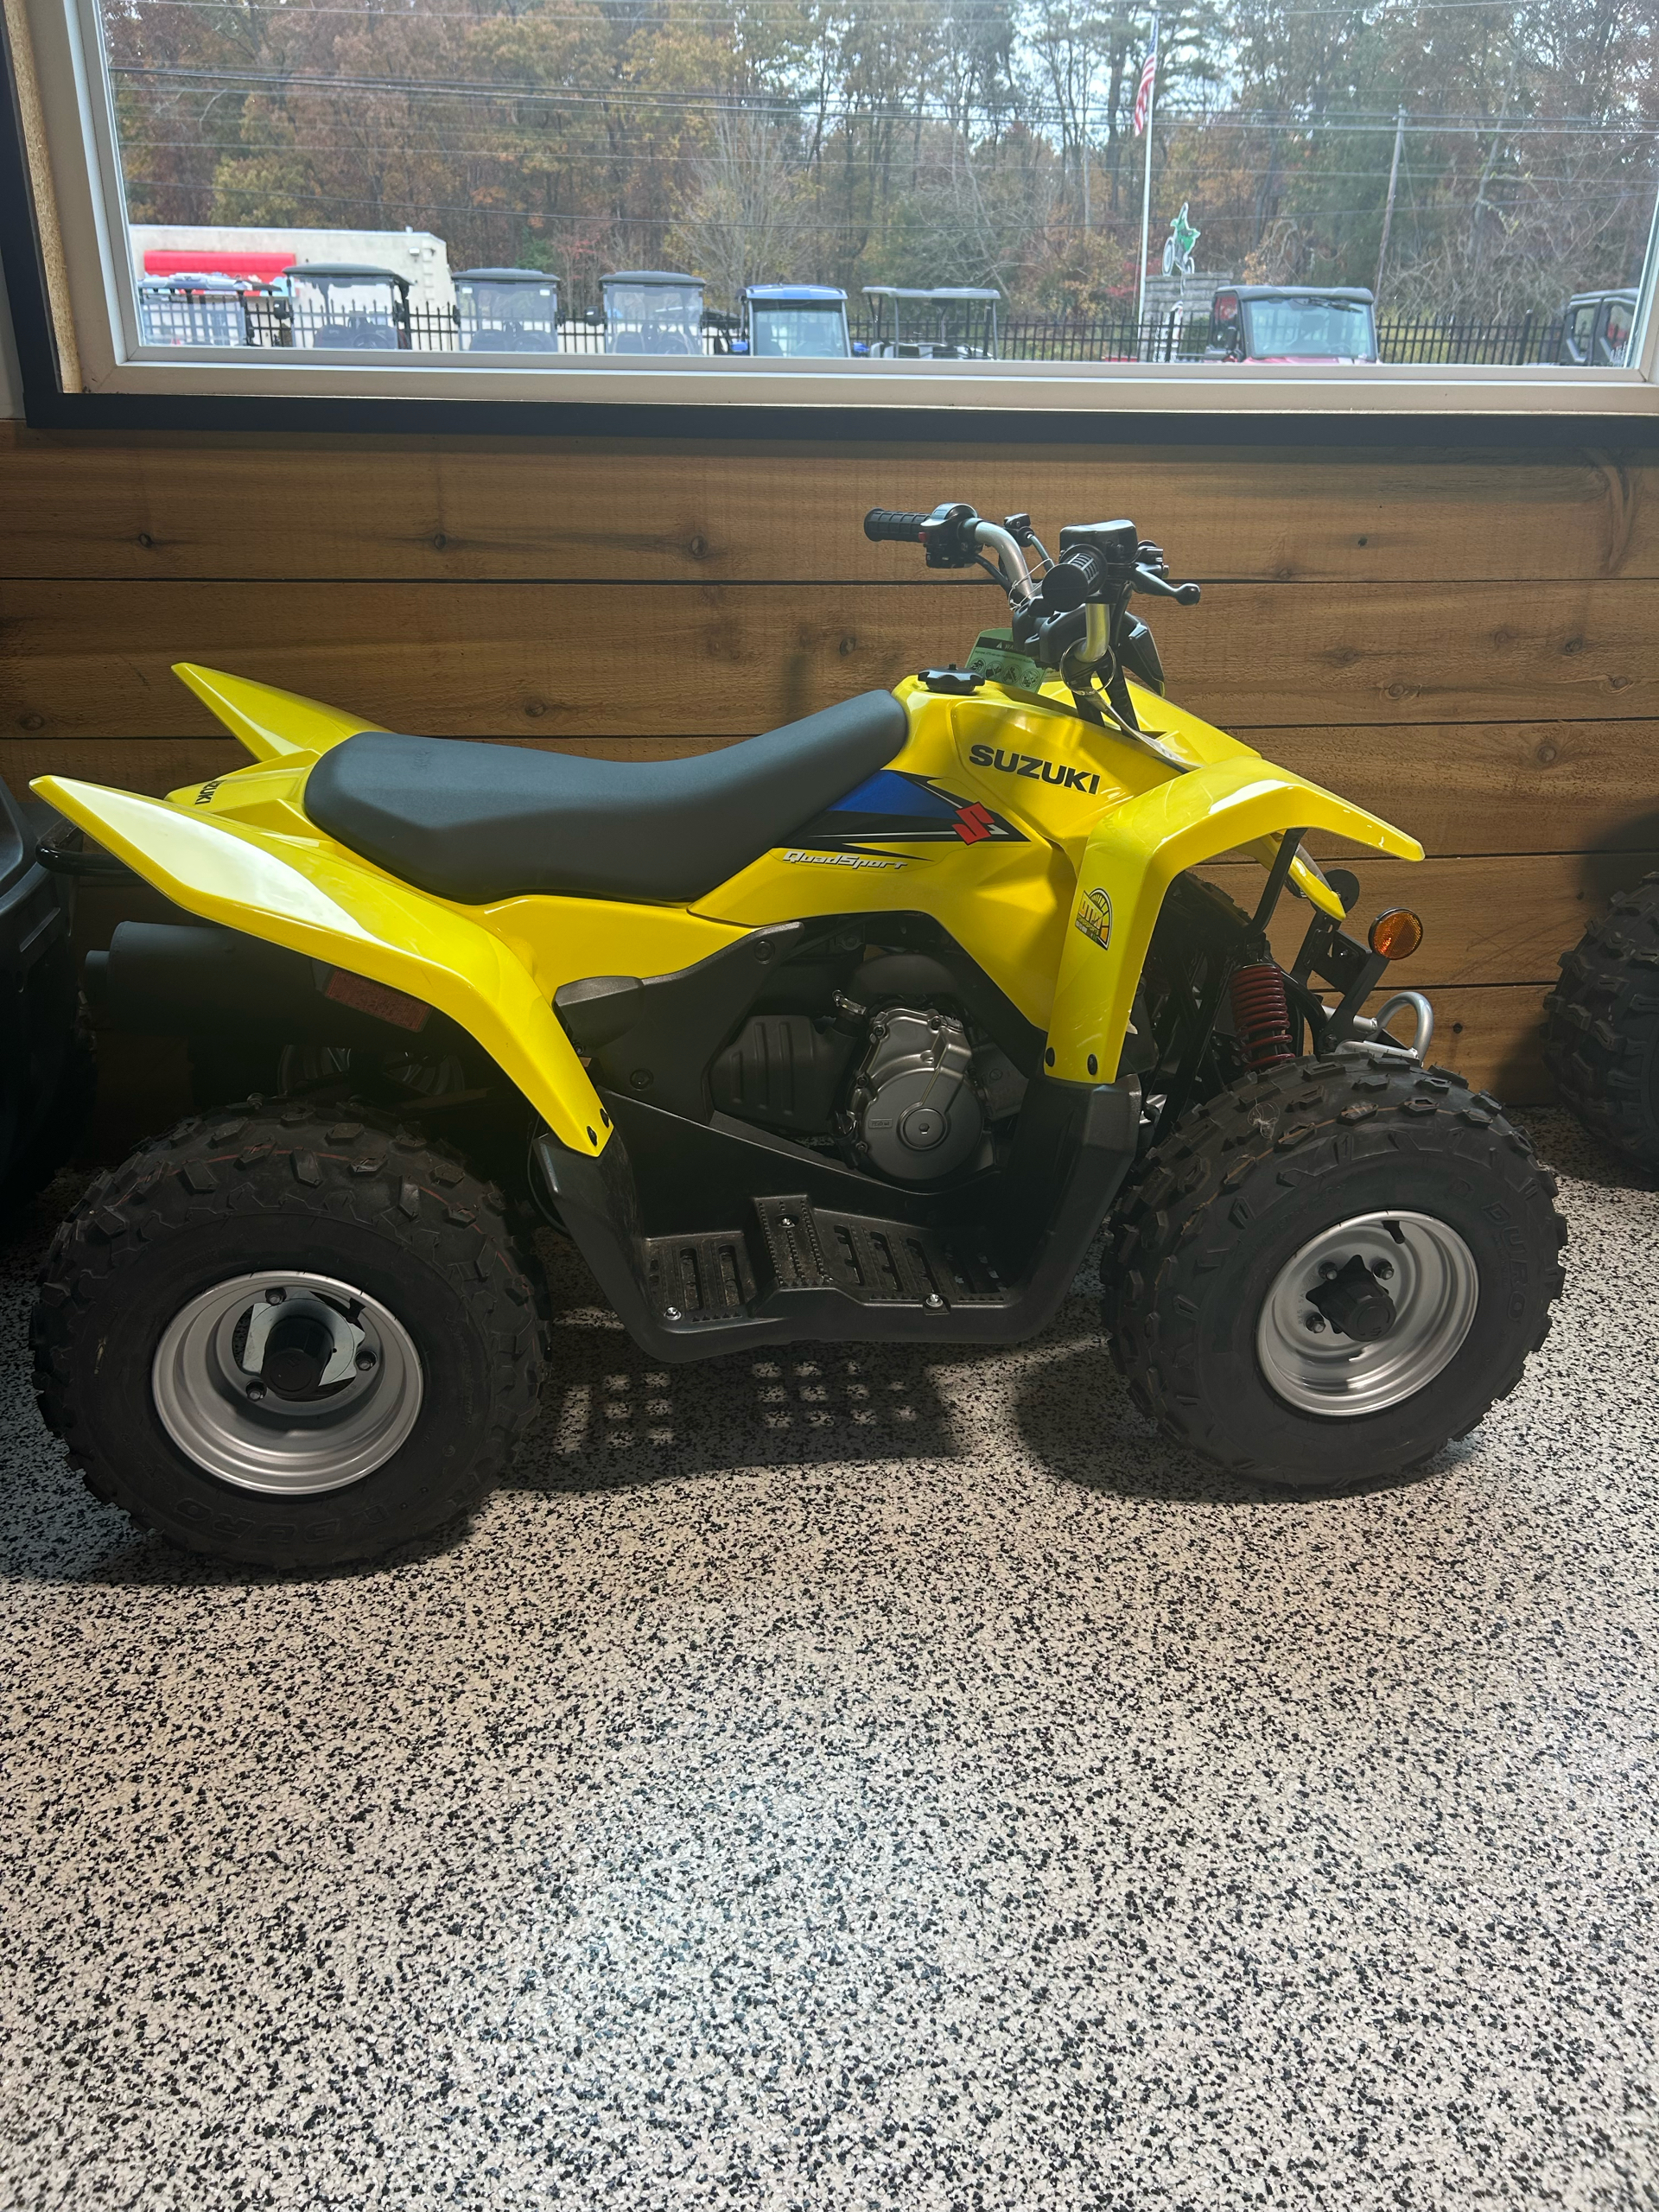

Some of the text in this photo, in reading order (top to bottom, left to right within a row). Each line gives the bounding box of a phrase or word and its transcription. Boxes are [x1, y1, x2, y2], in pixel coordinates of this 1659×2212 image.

[194, 779, 226, 804] ZUKI
[969, 744, 1101, 796] SUZUKI
[783, 850, 907, 870] QuadSport
[1480, 1200, 1529, 1322] DURO
[174, 1497, 340, 1544] DURO
